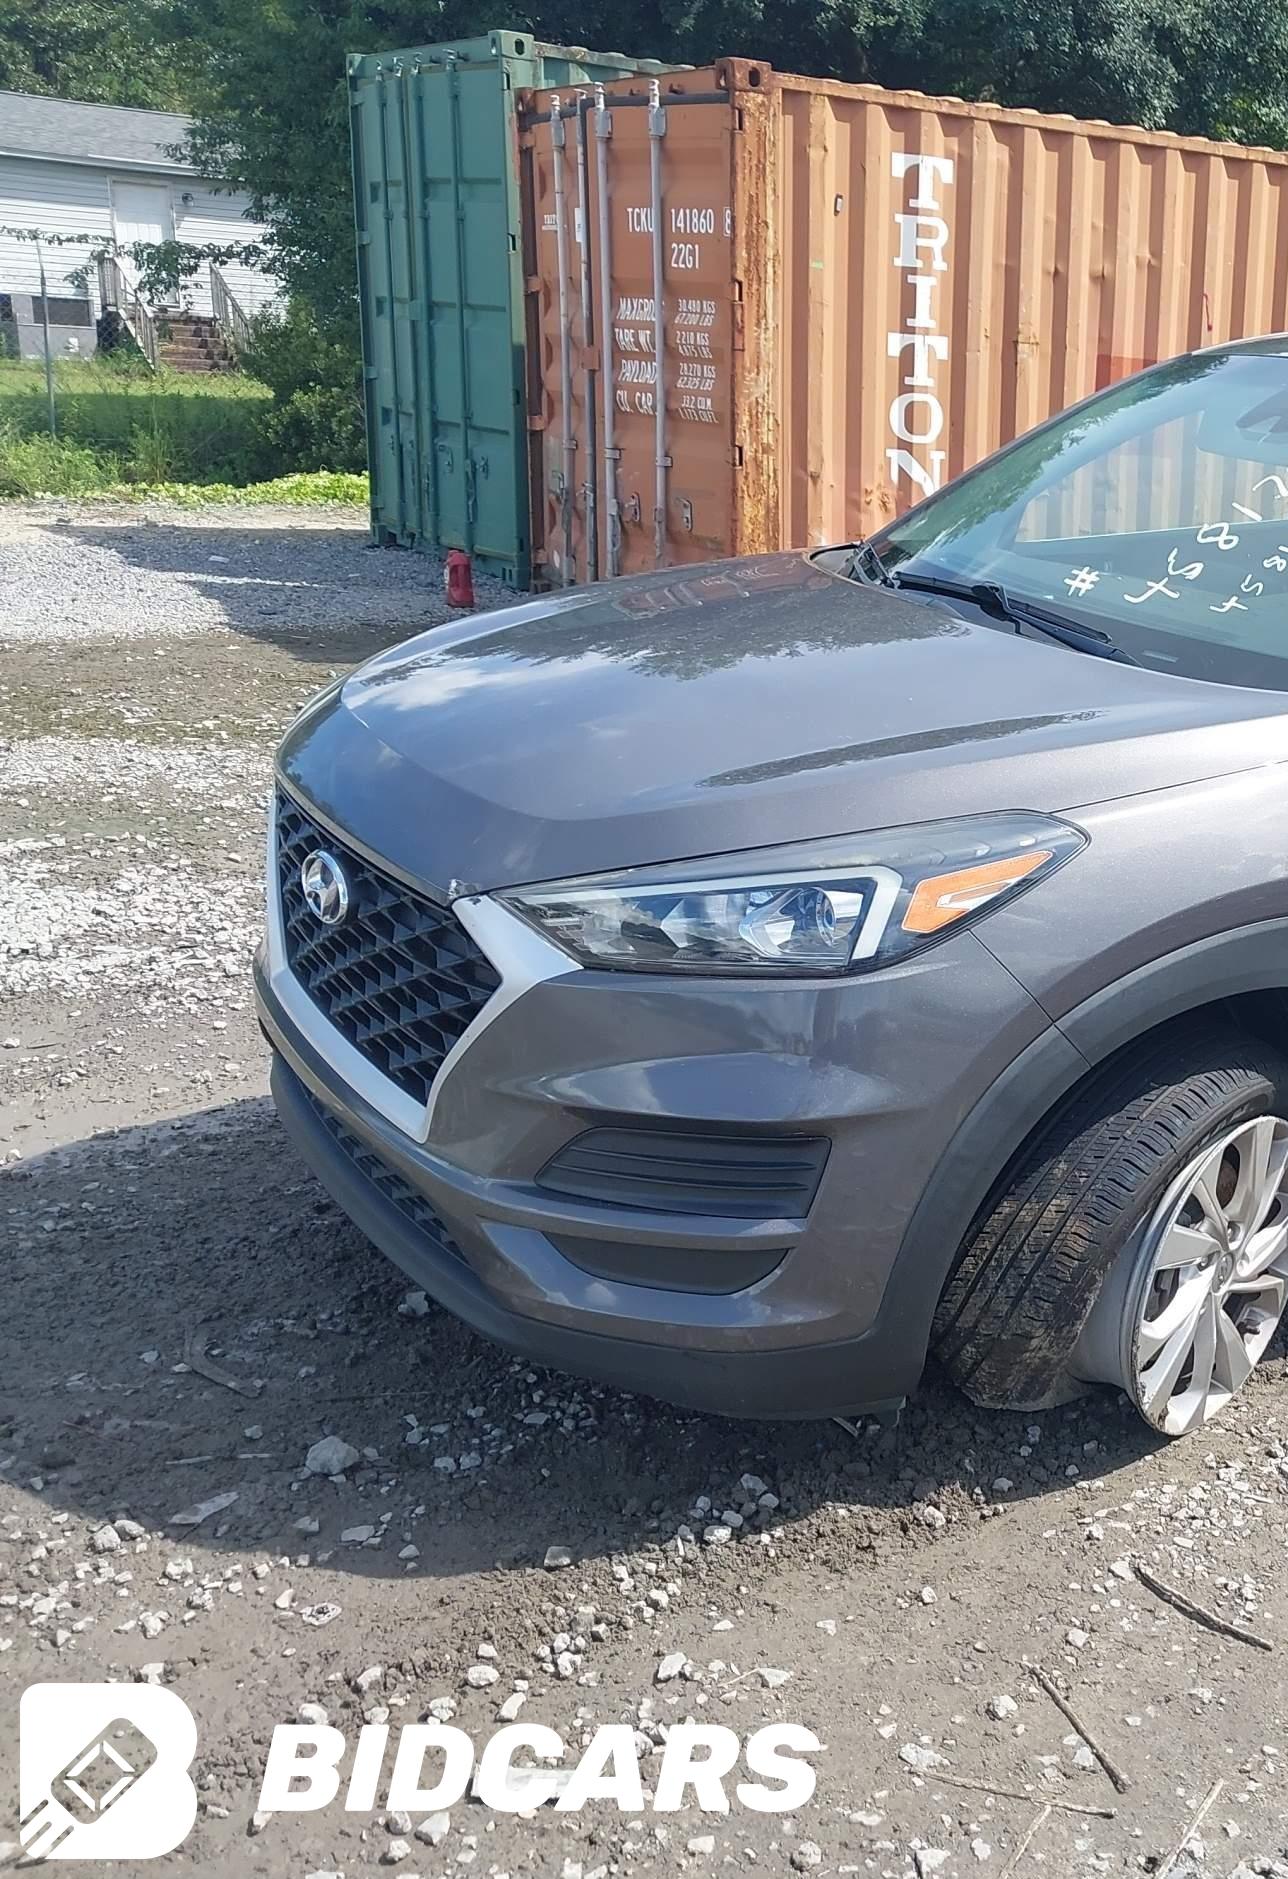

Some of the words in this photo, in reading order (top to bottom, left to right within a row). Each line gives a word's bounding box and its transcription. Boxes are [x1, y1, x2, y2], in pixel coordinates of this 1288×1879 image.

[626, 207, 656, 233] TCKU
[671, 207, 715, 234] 141860
[671, 242, 699, 269] 22G1
[616, 297, 657, 321] MAXGRO
[885, 151, 954, 498] TRITON
[614, 327, 640, 352] TARE
[617, 359, 657, 384] PAYLOAD
